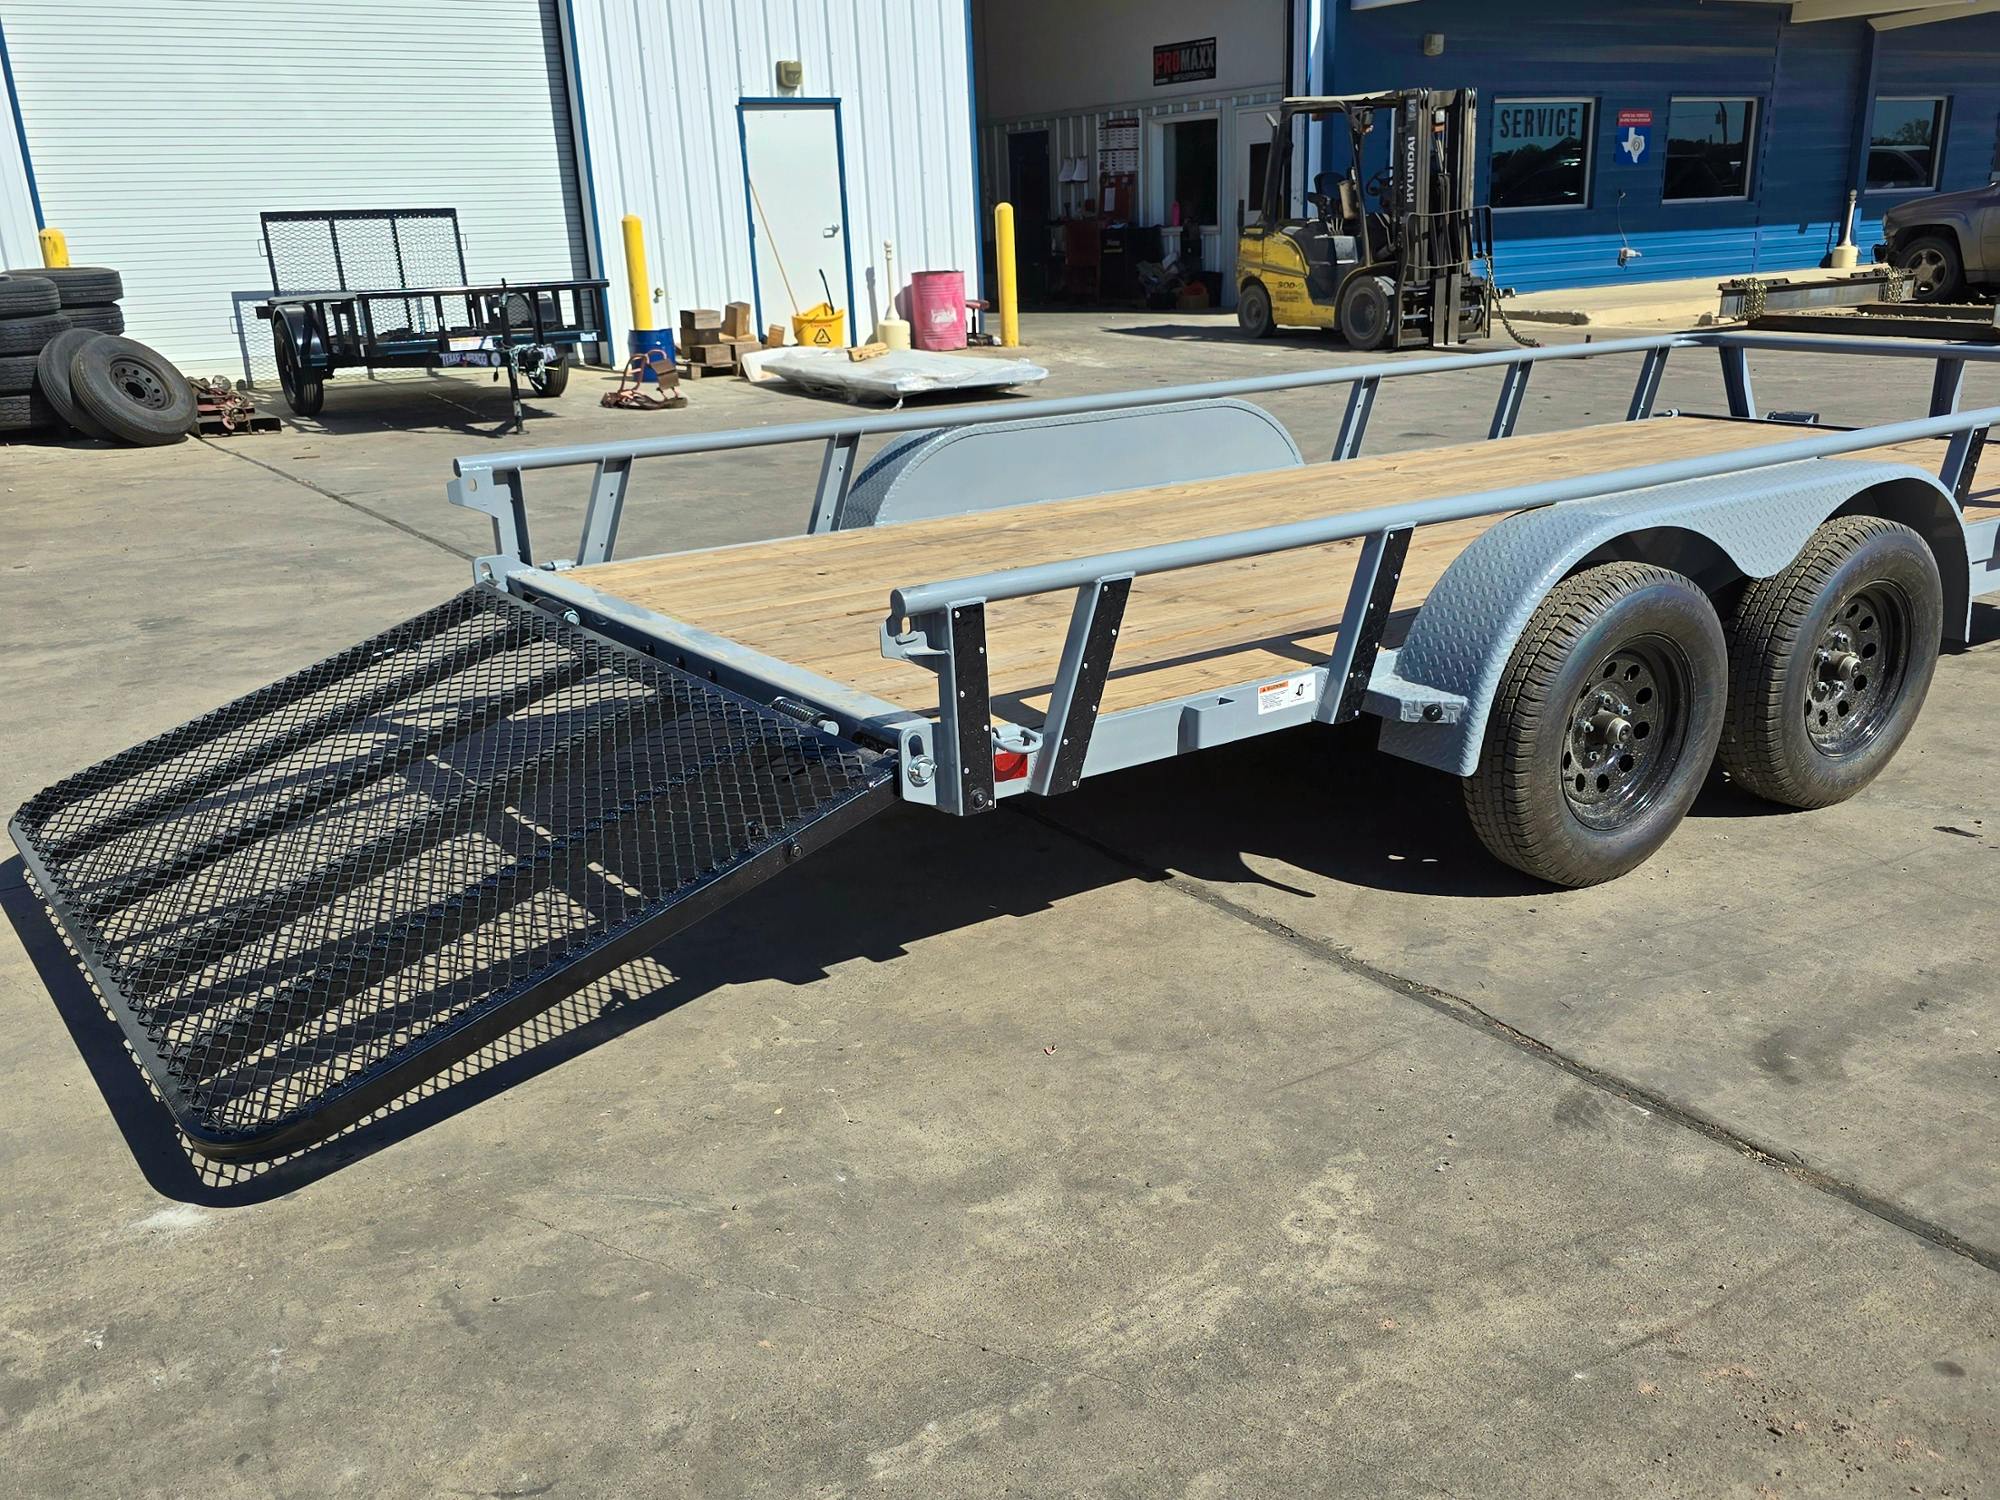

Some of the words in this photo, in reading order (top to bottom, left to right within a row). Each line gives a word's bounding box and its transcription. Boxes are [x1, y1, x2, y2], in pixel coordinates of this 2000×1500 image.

[1155, 45, 1215, 75] PROMAXX
[1500, 107, 1578, 138] SERVICE
[1406, 136, 1416, 203] HYUNDAI
